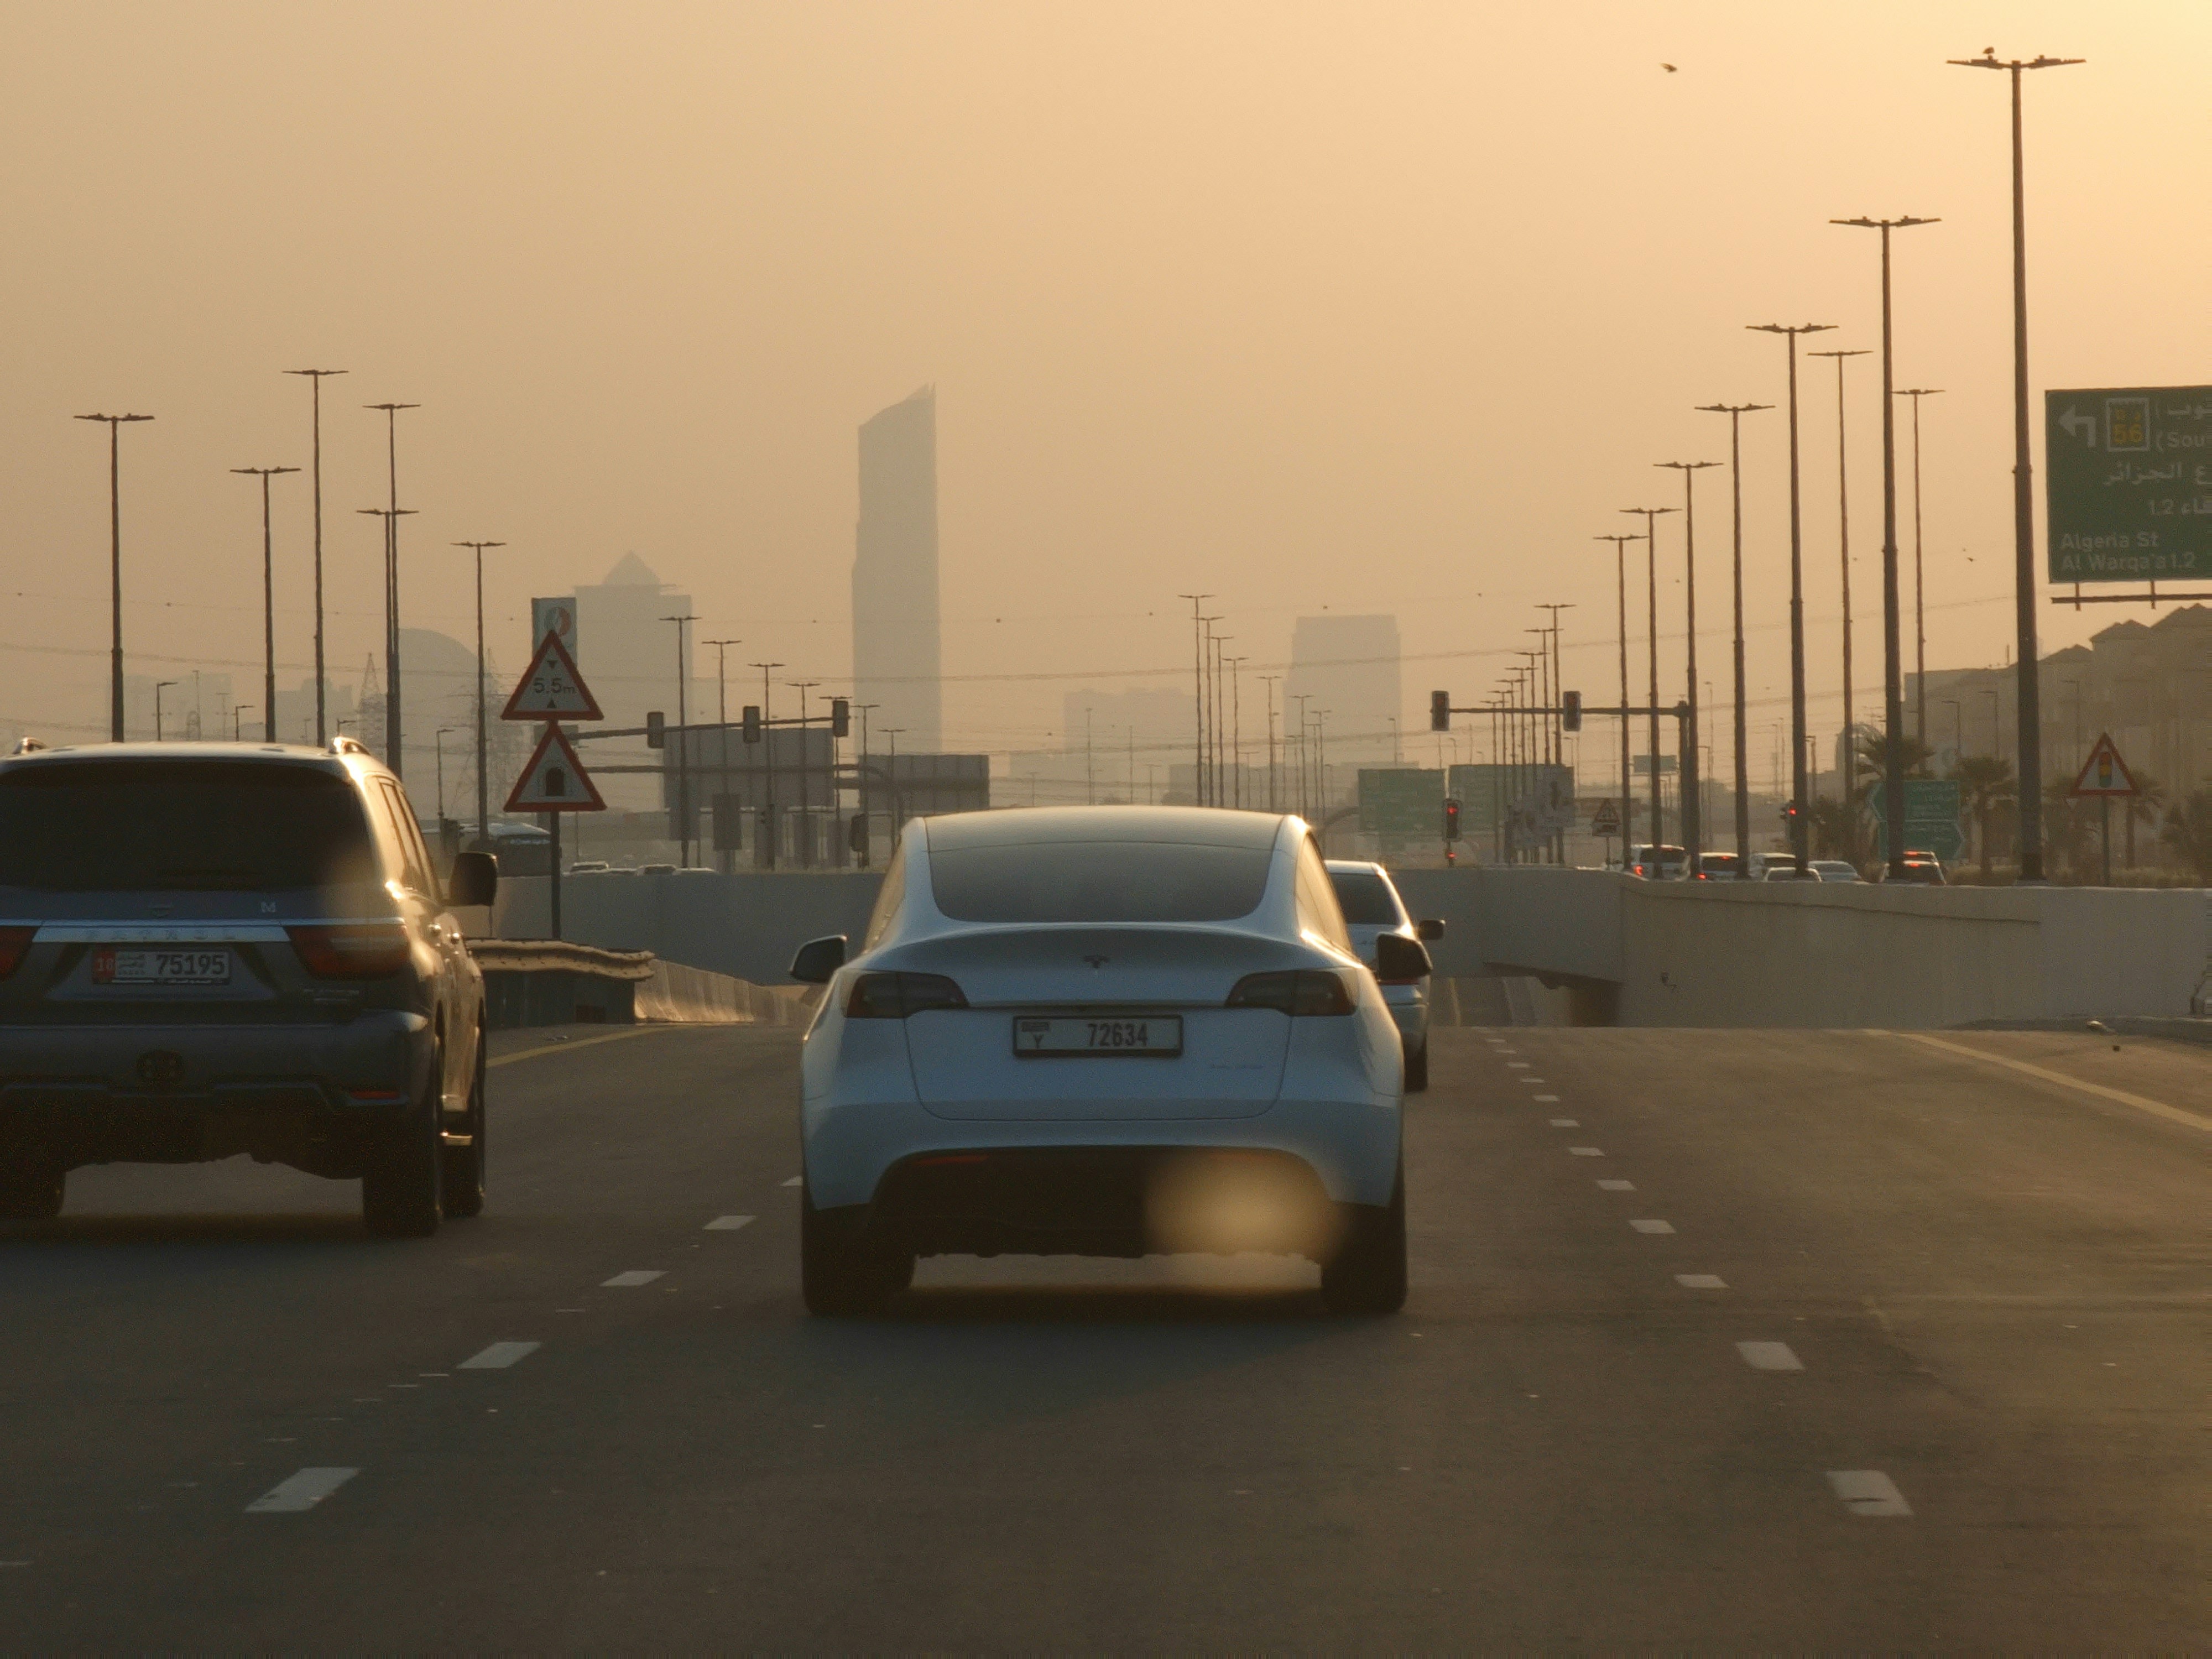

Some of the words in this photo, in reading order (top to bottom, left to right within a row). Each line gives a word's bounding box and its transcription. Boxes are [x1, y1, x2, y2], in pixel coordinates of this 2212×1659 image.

[2060, 532, 2130, 553] Algeria
[2136, 530, 2159, 548] St
[2060, 554, 2081, 572] Al
[156, 954, 226, 975] 75195
[1032, 1034, 1045, 1049] Y
[1087, 1023, 1149, 1047] 72634
